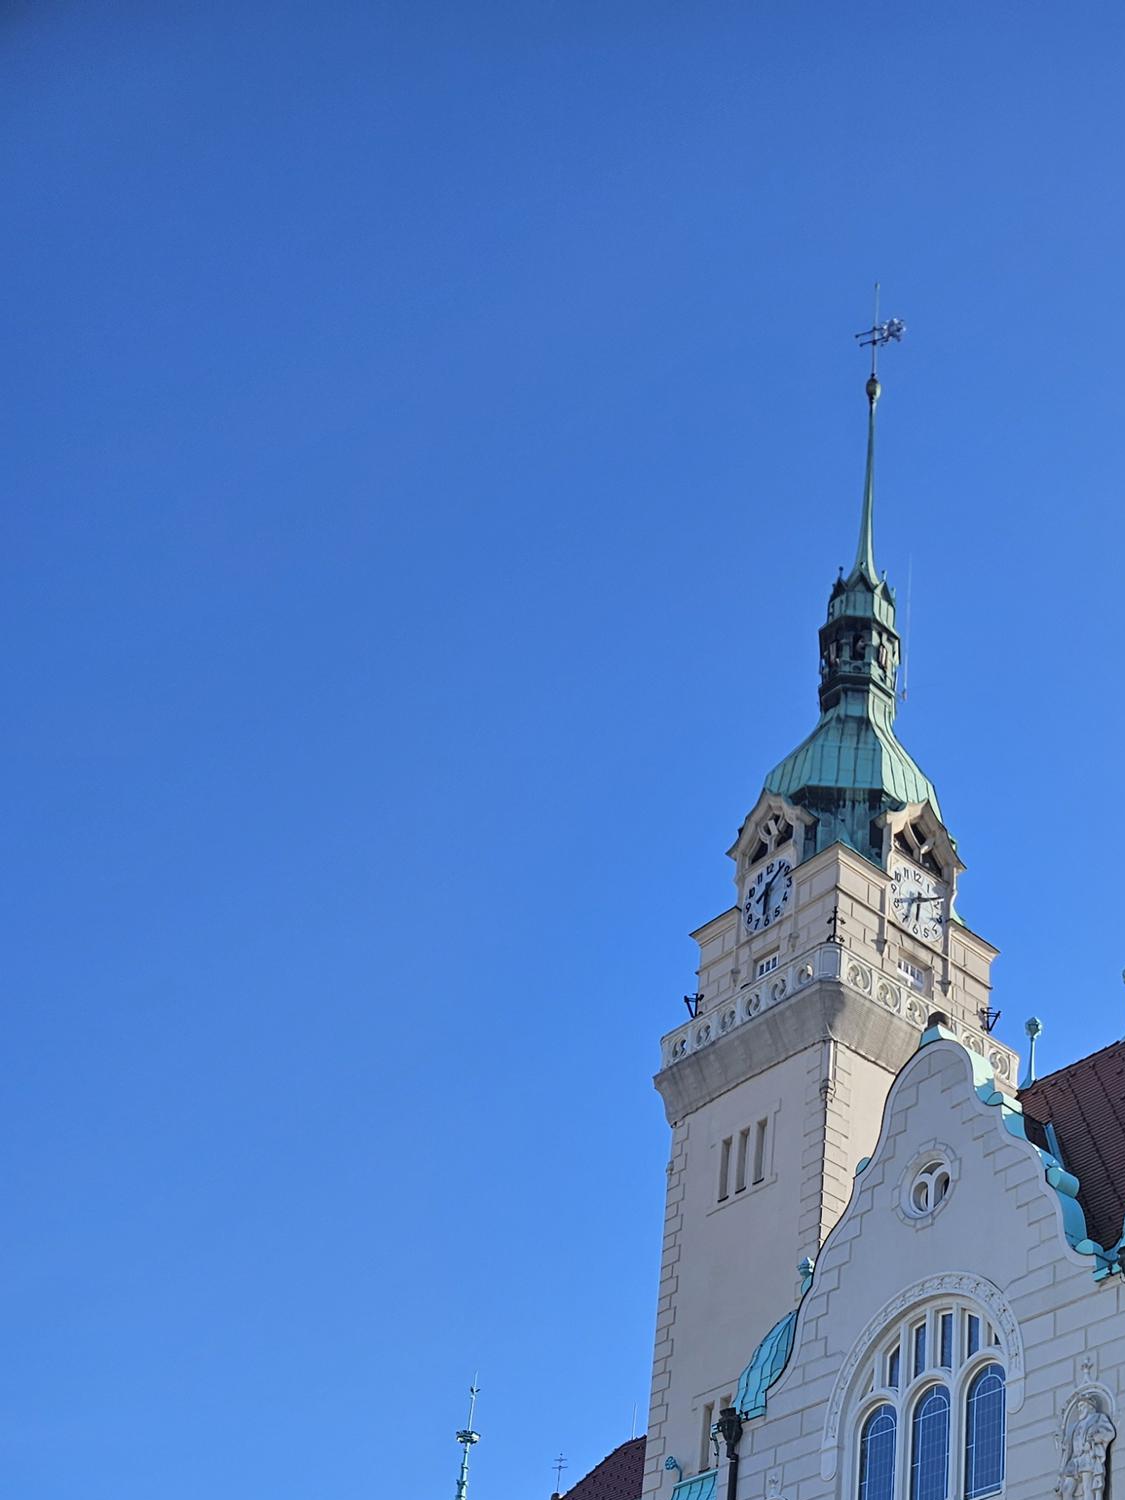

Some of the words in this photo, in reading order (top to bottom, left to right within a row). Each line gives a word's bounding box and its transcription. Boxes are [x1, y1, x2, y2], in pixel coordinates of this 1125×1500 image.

[767, 863, 774, 875] 12
[904, 867, 909, 879] 11
[758, 872, 763, 884] 11
[787, 876, 792, 888] 3
[894, 870, 901, 882] 10
[914, 870, 921, 883] 12
[749, 887, 755, 899] 10
[891, 884, 896, 893] 9
[782, 892, 787, 902] 4
[746, 902, 751, 913] 9
[775, 905, 780, 917] 5
[747, 914, 752, 924] 8
[754, 918, 760, 930] 7
[764, 915, 769, 927] 6
[912, 924, 918, 934] 6
[923, 928, 929, 938] 5
[932, 924, 937, 934] 4
